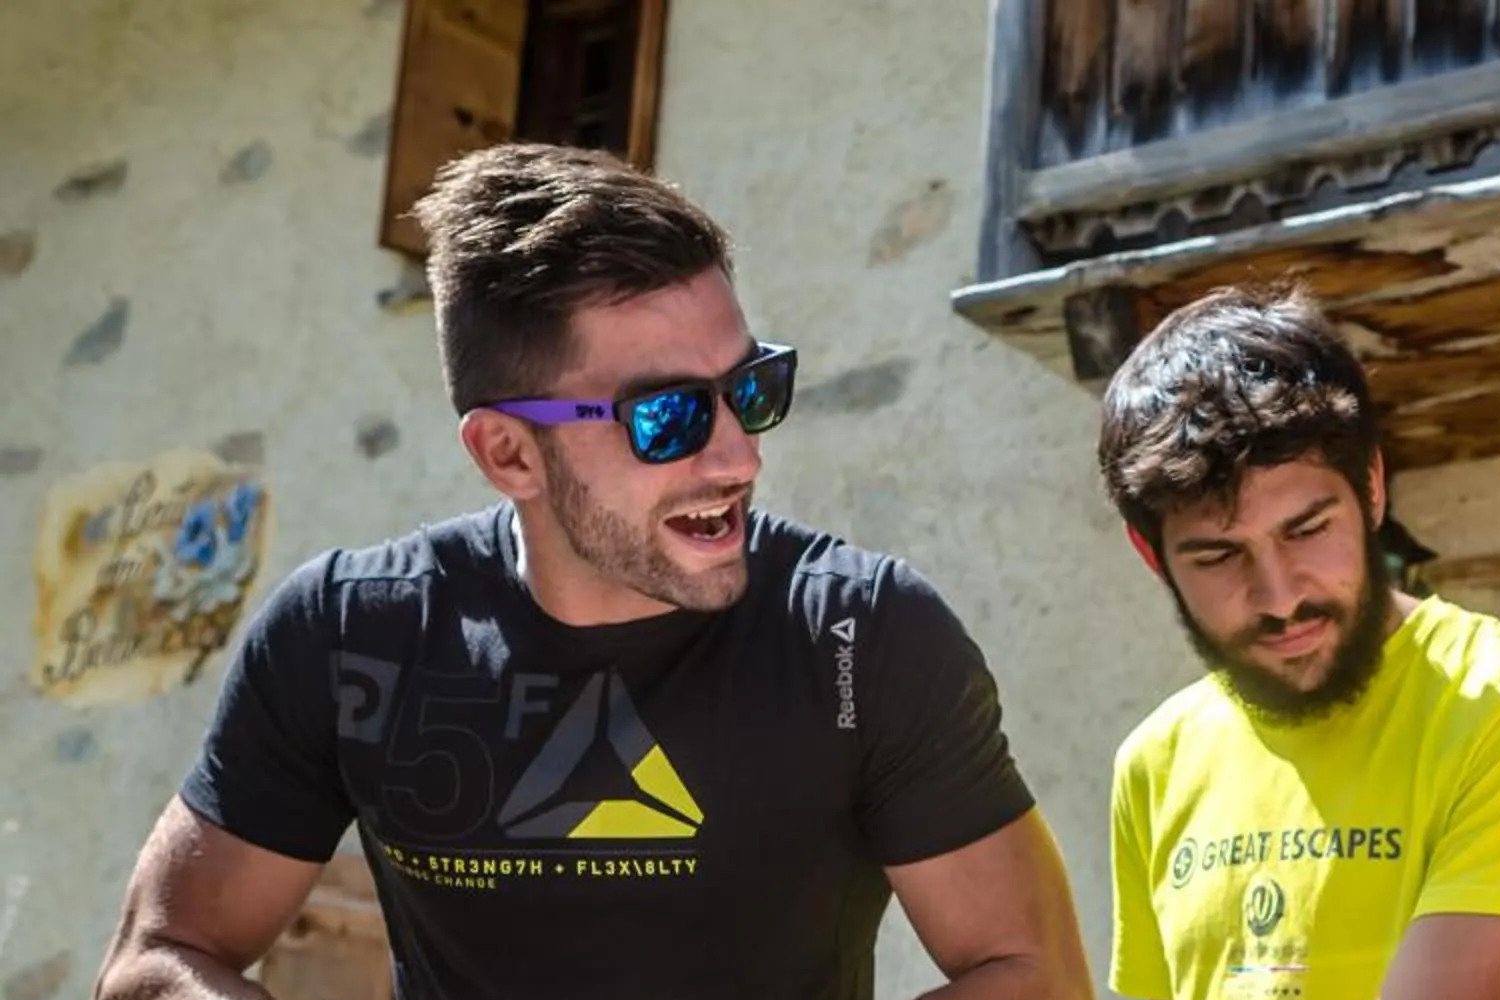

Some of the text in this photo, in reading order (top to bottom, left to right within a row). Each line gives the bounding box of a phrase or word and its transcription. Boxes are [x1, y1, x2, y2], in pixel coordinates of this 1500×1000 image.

[835, 645, 857, 729] Reebok
[1202, 827, 1403, 871] GREAT ESCAPES
